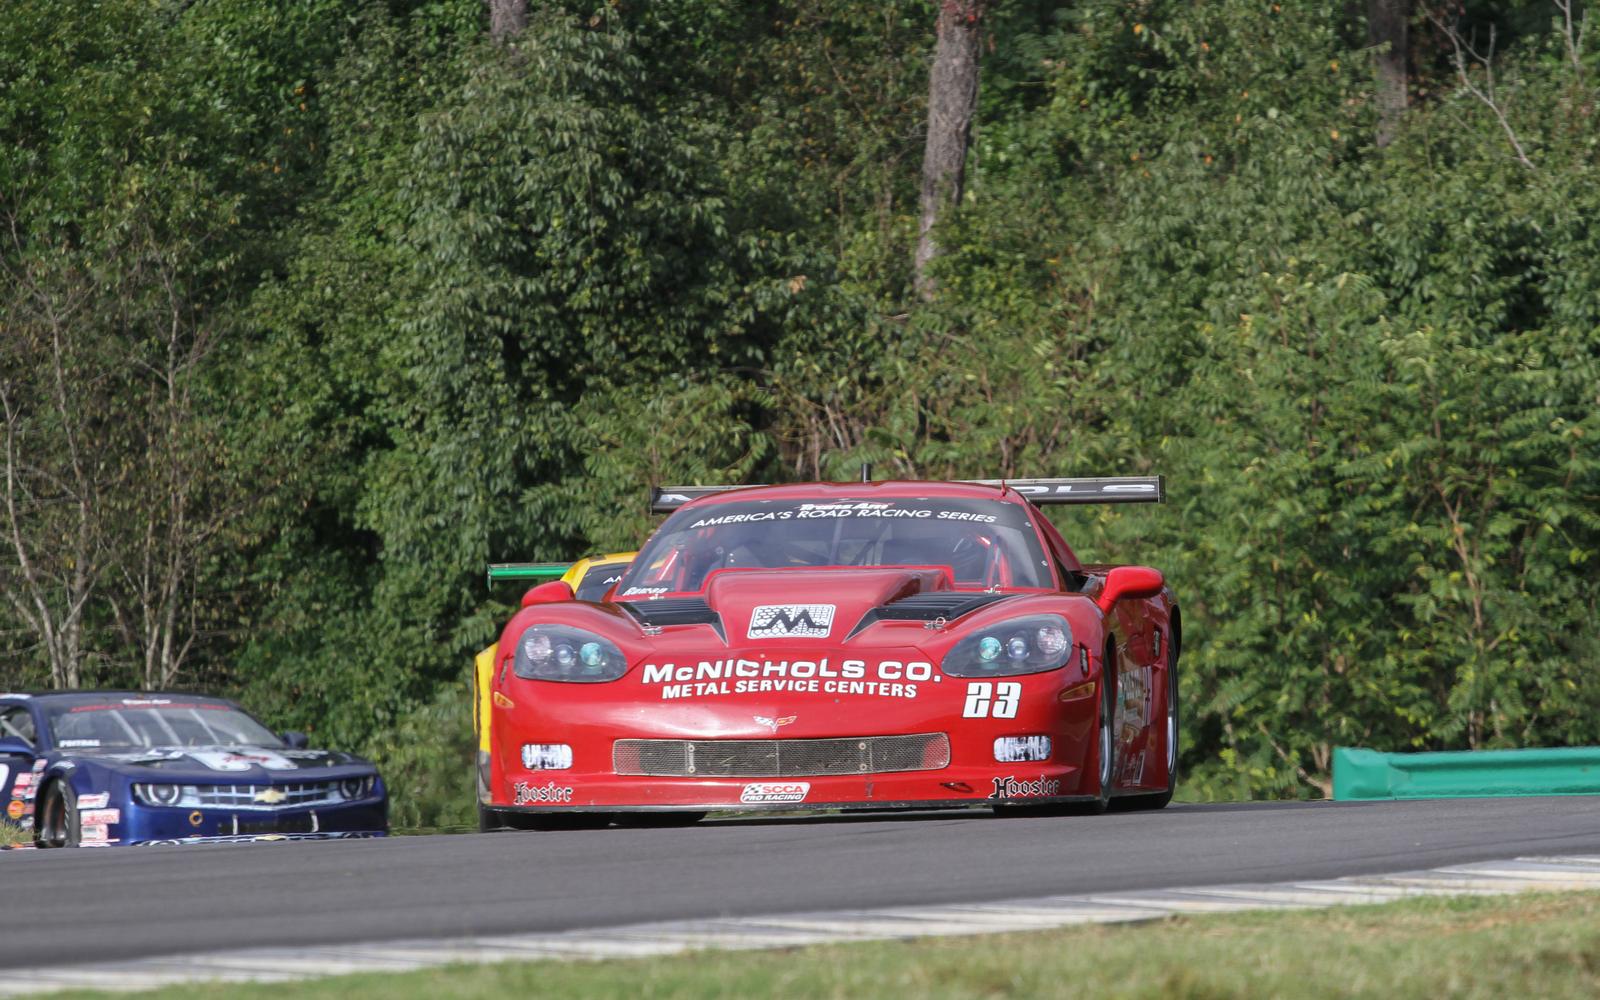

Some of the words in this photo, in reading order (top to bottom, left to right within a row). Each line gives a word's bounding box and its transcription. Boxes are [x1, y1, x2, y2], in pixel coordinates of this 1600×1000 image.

[689, 511, 793, 529] AMERICA'S
[797, 509, 852, 519] ROAD
[856, 509, 933, 518] RACING
[937, 511, 998, 523] SERIES
[641, 658, 866, 684] McNICHOLS
[877, 660, 942, 682] CO.
[662, 681, 731, 699] METAL
[735, 680, 820, 694] SERVICE
[824, 680, 918, 698] CENTERS
[962, 681, 1022, 718] 23
[513, 781, 574, 805] Hoosier
[762, 785, 804, 794] SCCA
[988, 774, 1060, 799] Hoosier
